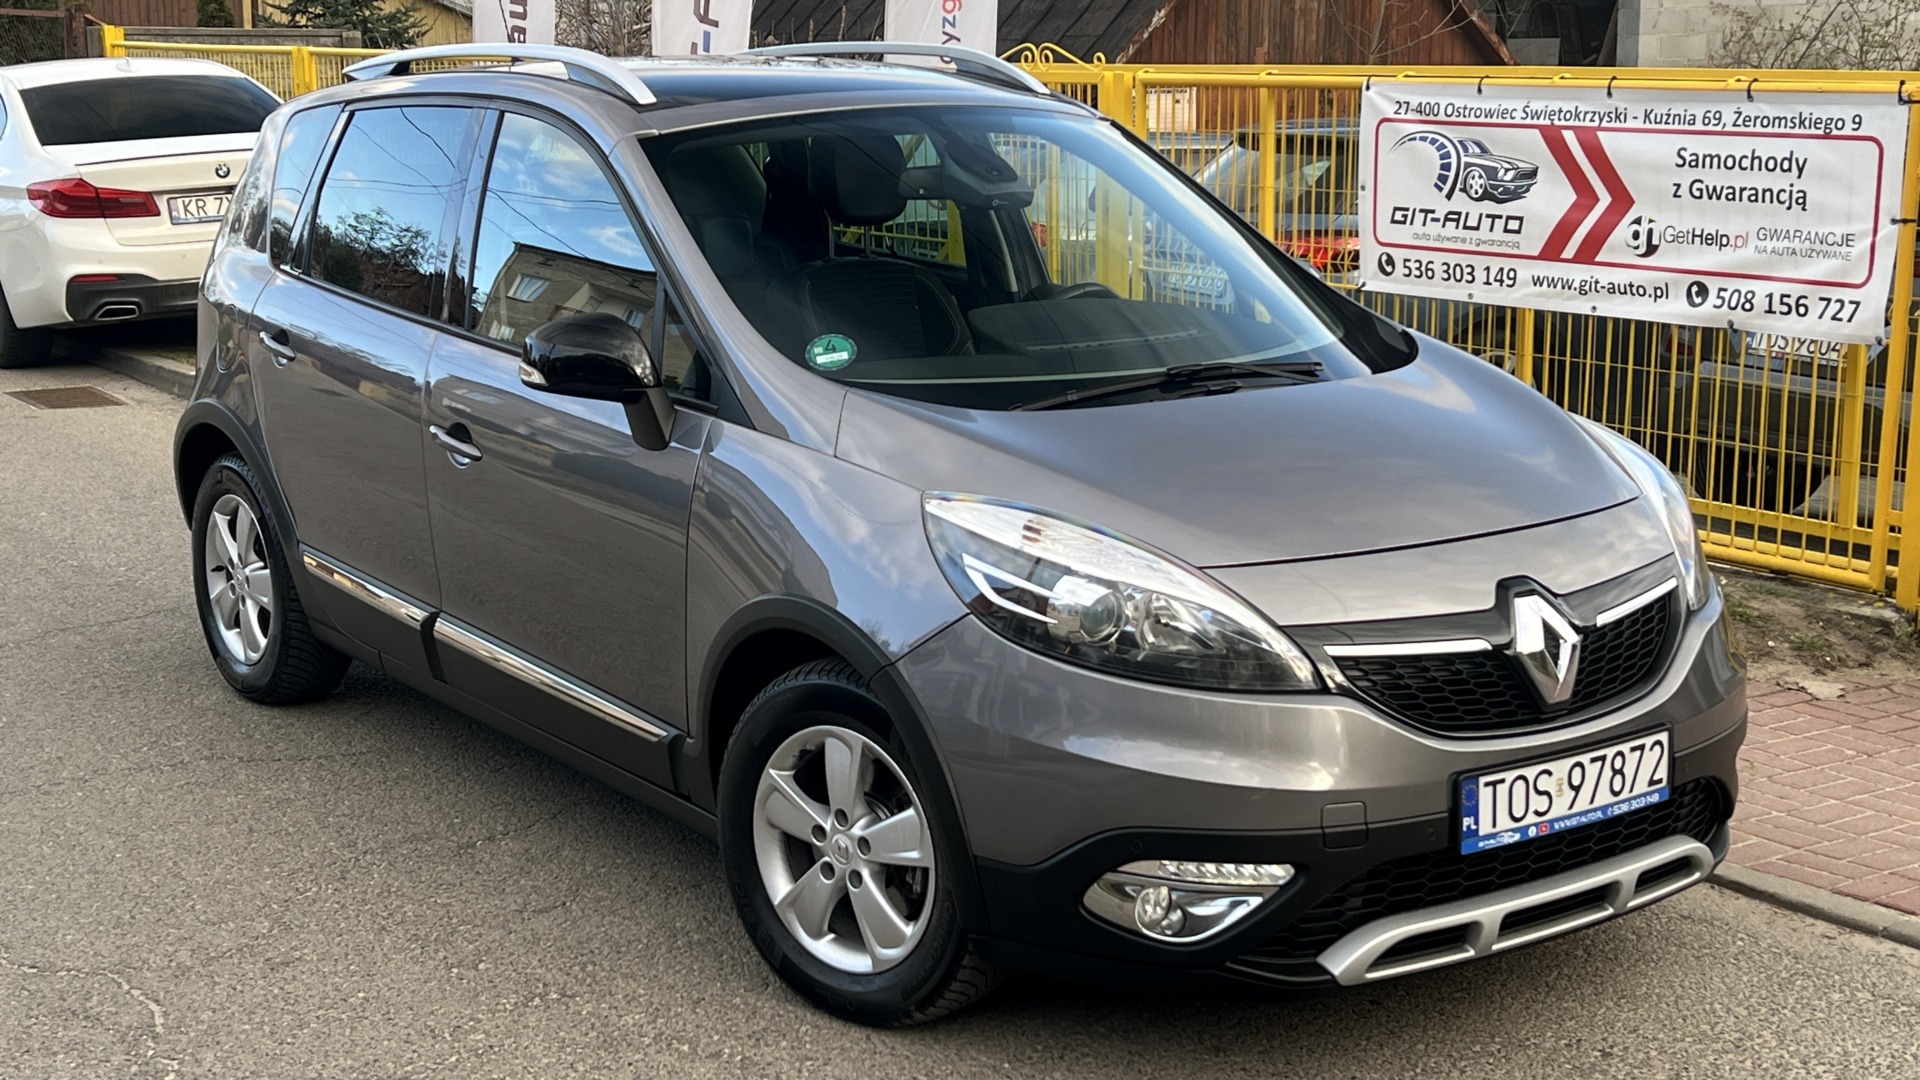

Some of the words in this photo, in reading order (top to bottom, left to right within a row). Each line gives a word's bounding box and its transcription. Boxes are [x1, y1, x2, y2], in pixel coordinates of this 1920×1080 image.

[1394, 101, 1440, 118] 27-400
[1444, 103, 1517, 120] Ostrowiec
[1521, 101, 1628, 126] Świętokrzyski
[1643, 107, 1697, 127] Kuźnia
[1702, 110, 1727, 130] 69,
[1732, 107, 1846, 134] Żeromskiego
[1851, 114, 1863, 132] 9
[1675, 147, 1808, 179] Samochody
[182, 198, 208, 217] KR
[1672, 182, 1682, 199] z
[1688, 179, 1808, 212] Gwarancją
[1390, 206, 1525, 235] GIT-AUTO
[1412, 231, 1431, 241] auta
[1432, 231, 1467, 245] używane
[1469, 236, 1474, 244] z
[1475, 237, 1520, 250] gwarancją
[1663, 225, 1749, 251] GetHelp.pl
[1754, 245, 1768, 255] NA
[1770, 246, 1798, 257] AUTA
[1756, 227, 1856, 248] GWARANCJE
[1402, 258, 1435, 280] 536
[1441, 262, 1476, 284] 303
[1483, 265, 1517, 288] 149
[1532, 273, 1669, 303] www.git-auto.pl
[1713, 287, 1756, 313] 508
[1763, 292, 1809, 318] 156
[1817, 297, 1862, 323] 727
[825, 339, 837, 352] 4
[1483, 768, 1553, 829] TOS
[1567, 739, 1665, 811] 97872
[1463, 816, 1478, 832] PL
